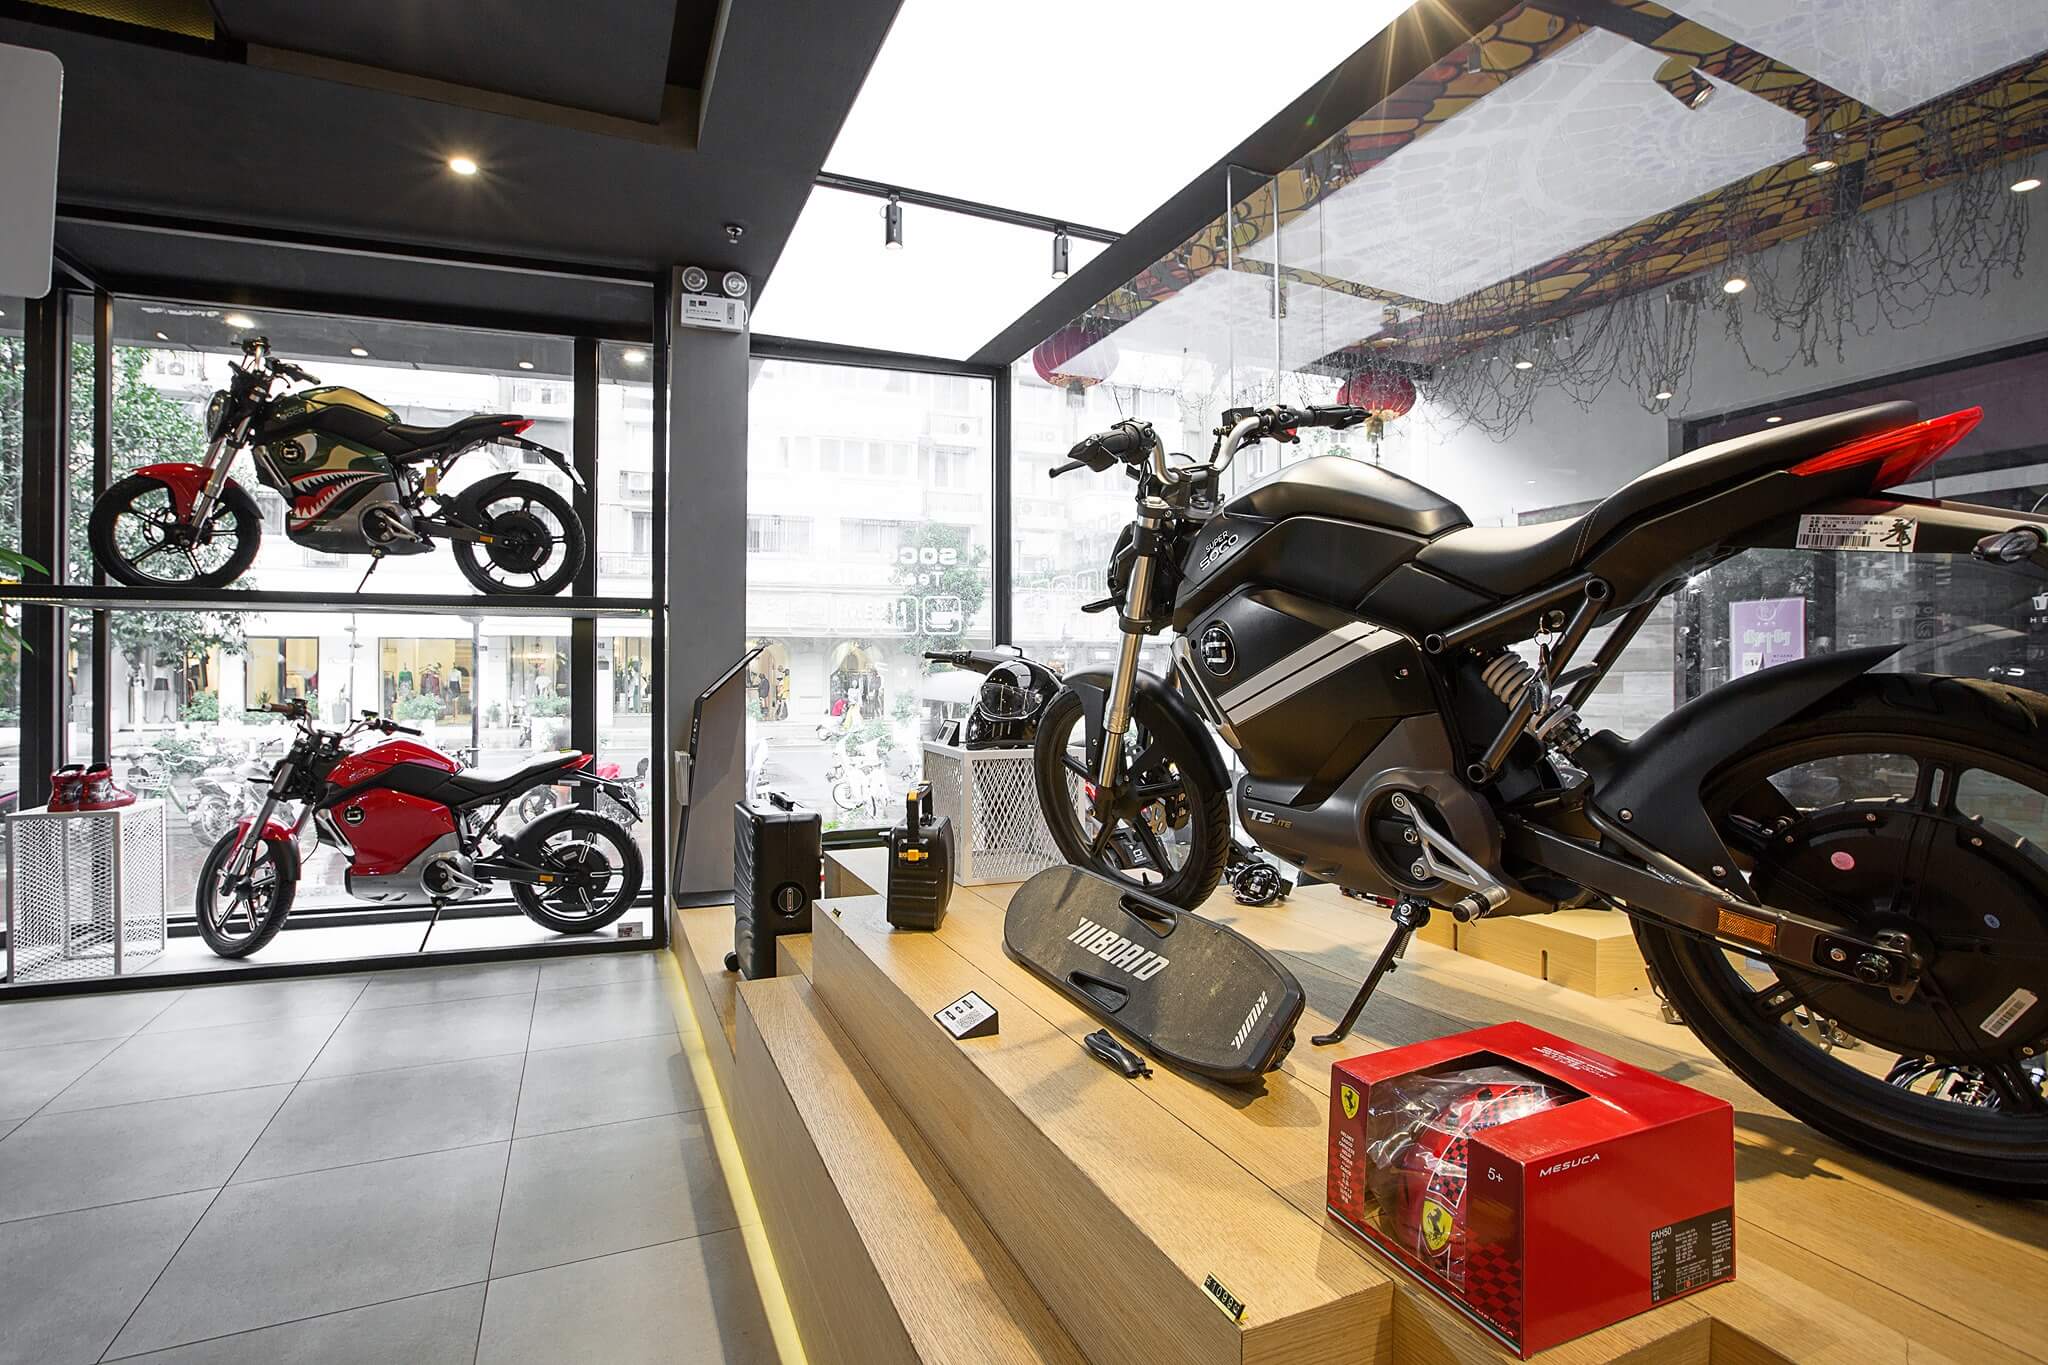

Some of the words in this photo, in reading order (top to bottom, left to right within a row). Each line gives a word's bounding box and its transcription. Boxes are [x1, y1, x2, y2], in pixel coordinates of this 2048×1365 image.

[1200, 534, 1239, 570] SOCO
[1205, 530, 1229, 553] SUPER
[1487, 1167, 1503, 1182] 5+
[1539, 1153, 1600, 1178] MESUCA
